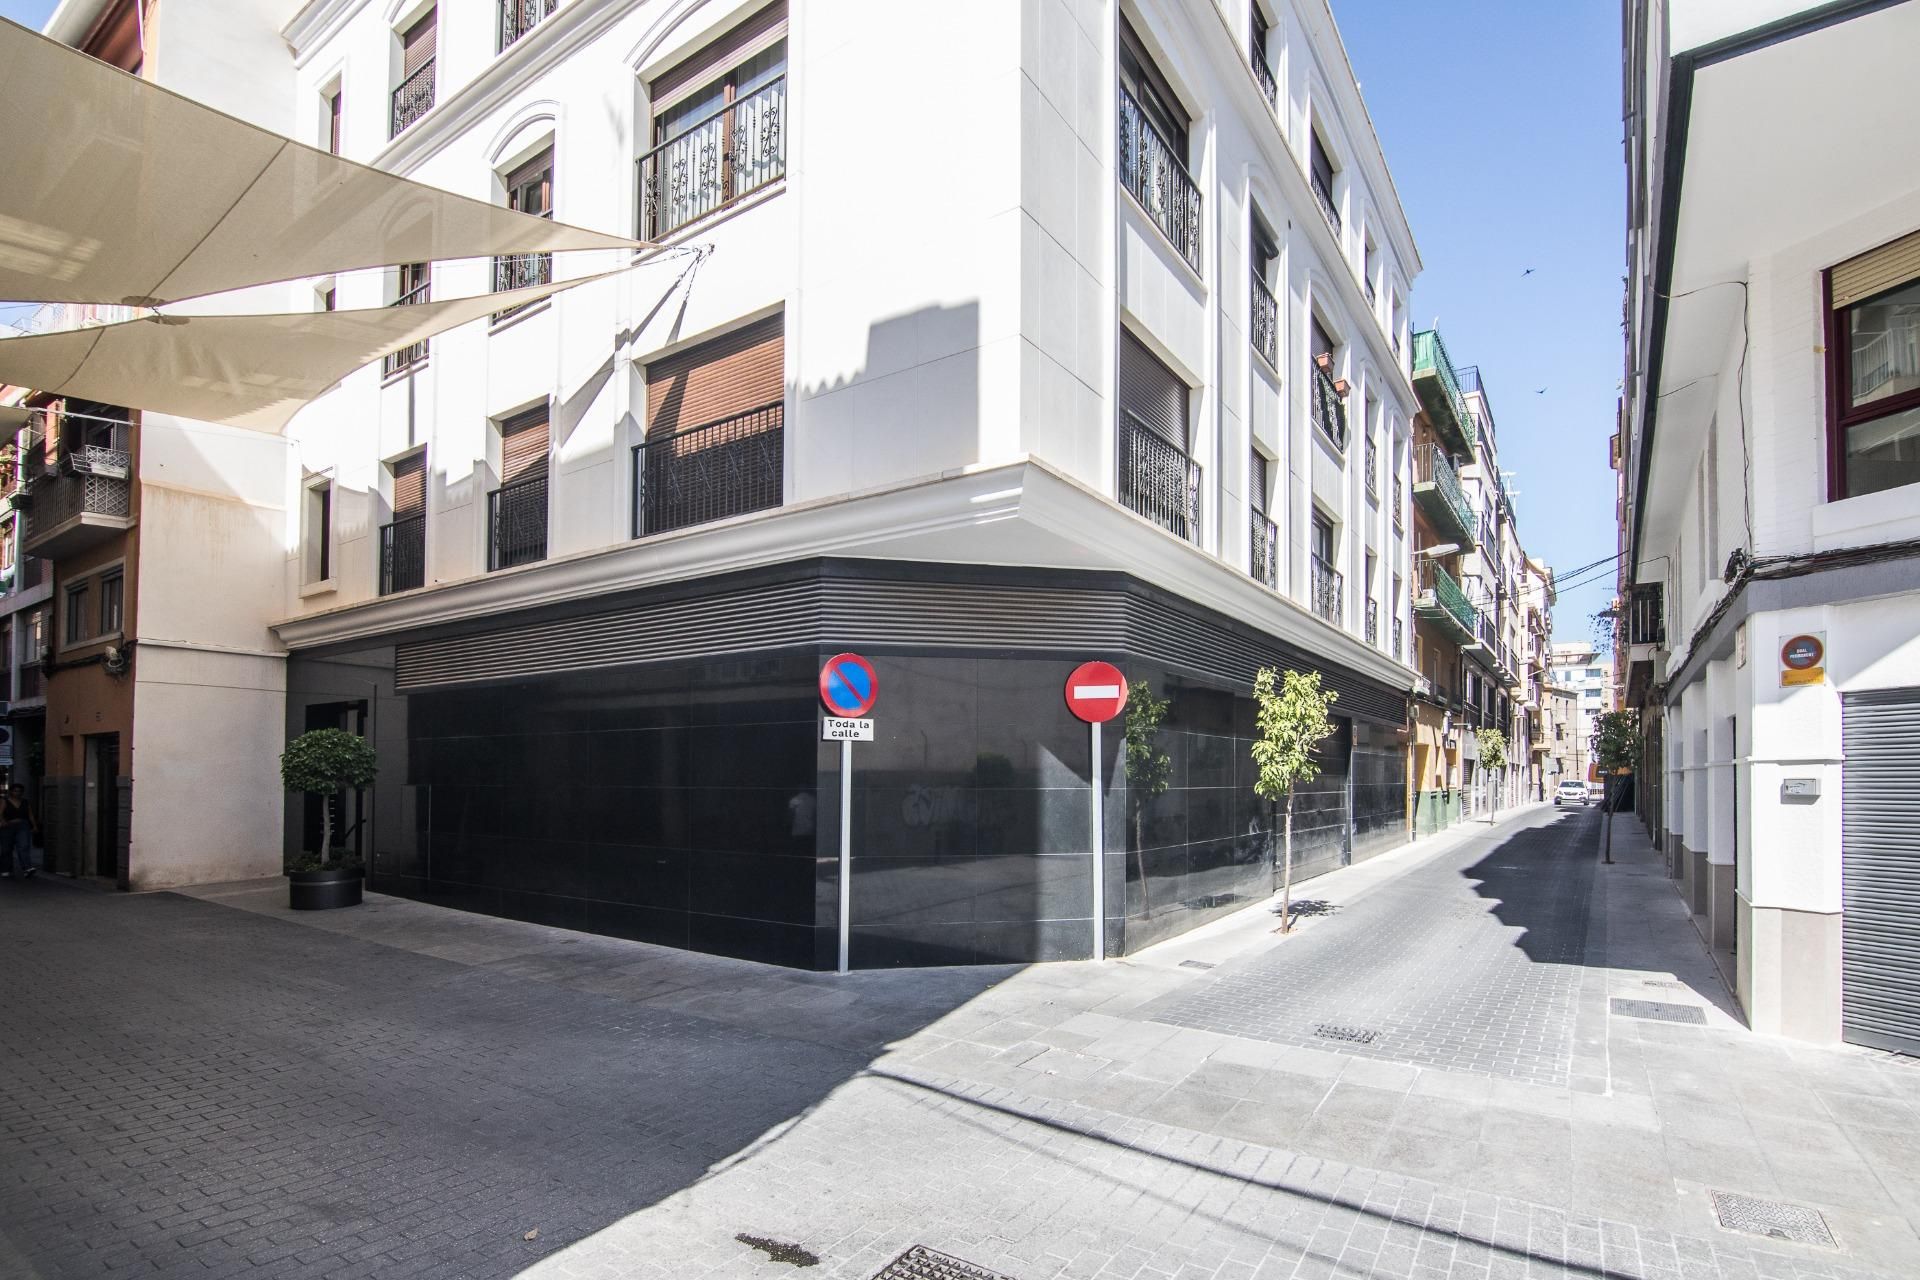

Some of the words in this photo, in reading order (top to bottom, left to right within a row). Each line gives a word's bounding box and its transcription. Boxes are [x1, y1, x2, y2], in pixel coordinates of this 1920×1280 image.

[828, 719, 855, 728] Toda
[859, 721, 870, 729] la
[831, 729, 860, 738] calle
